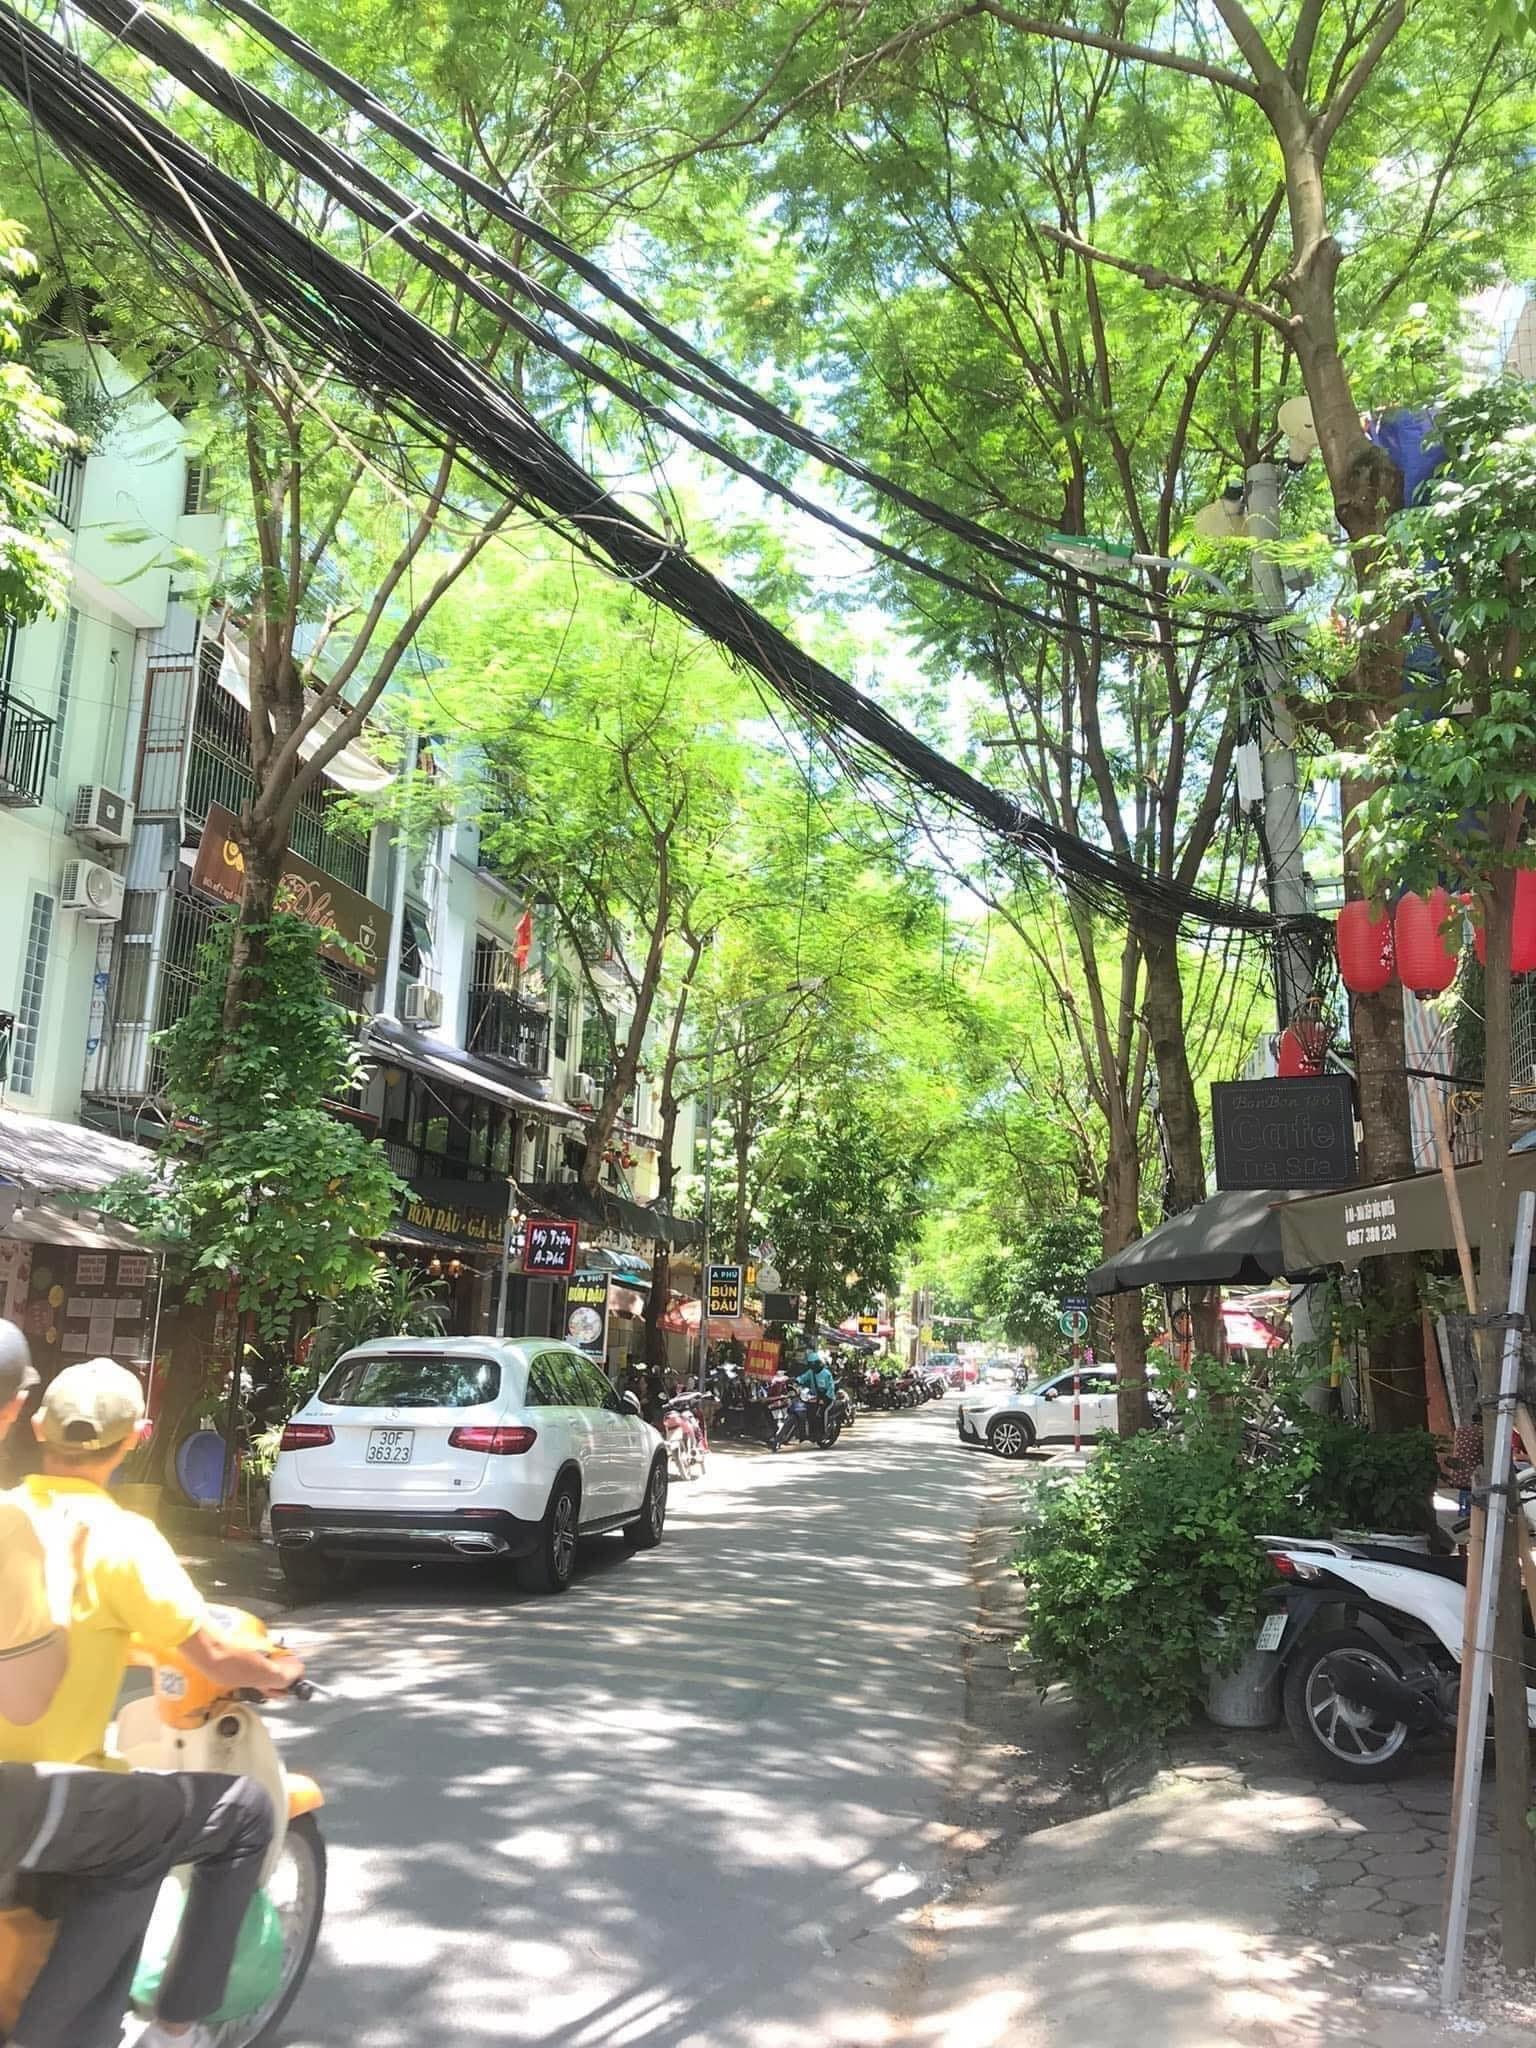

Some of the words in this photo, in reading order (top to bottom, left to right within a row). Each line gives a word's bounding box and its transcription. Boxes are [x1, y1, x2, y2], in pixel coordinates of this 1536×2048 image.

[711, 1283, 737, 1297] BÚN
[379, 1431, 404, 1446] 30F
[368, 1446, 410, 1461] 363.23
